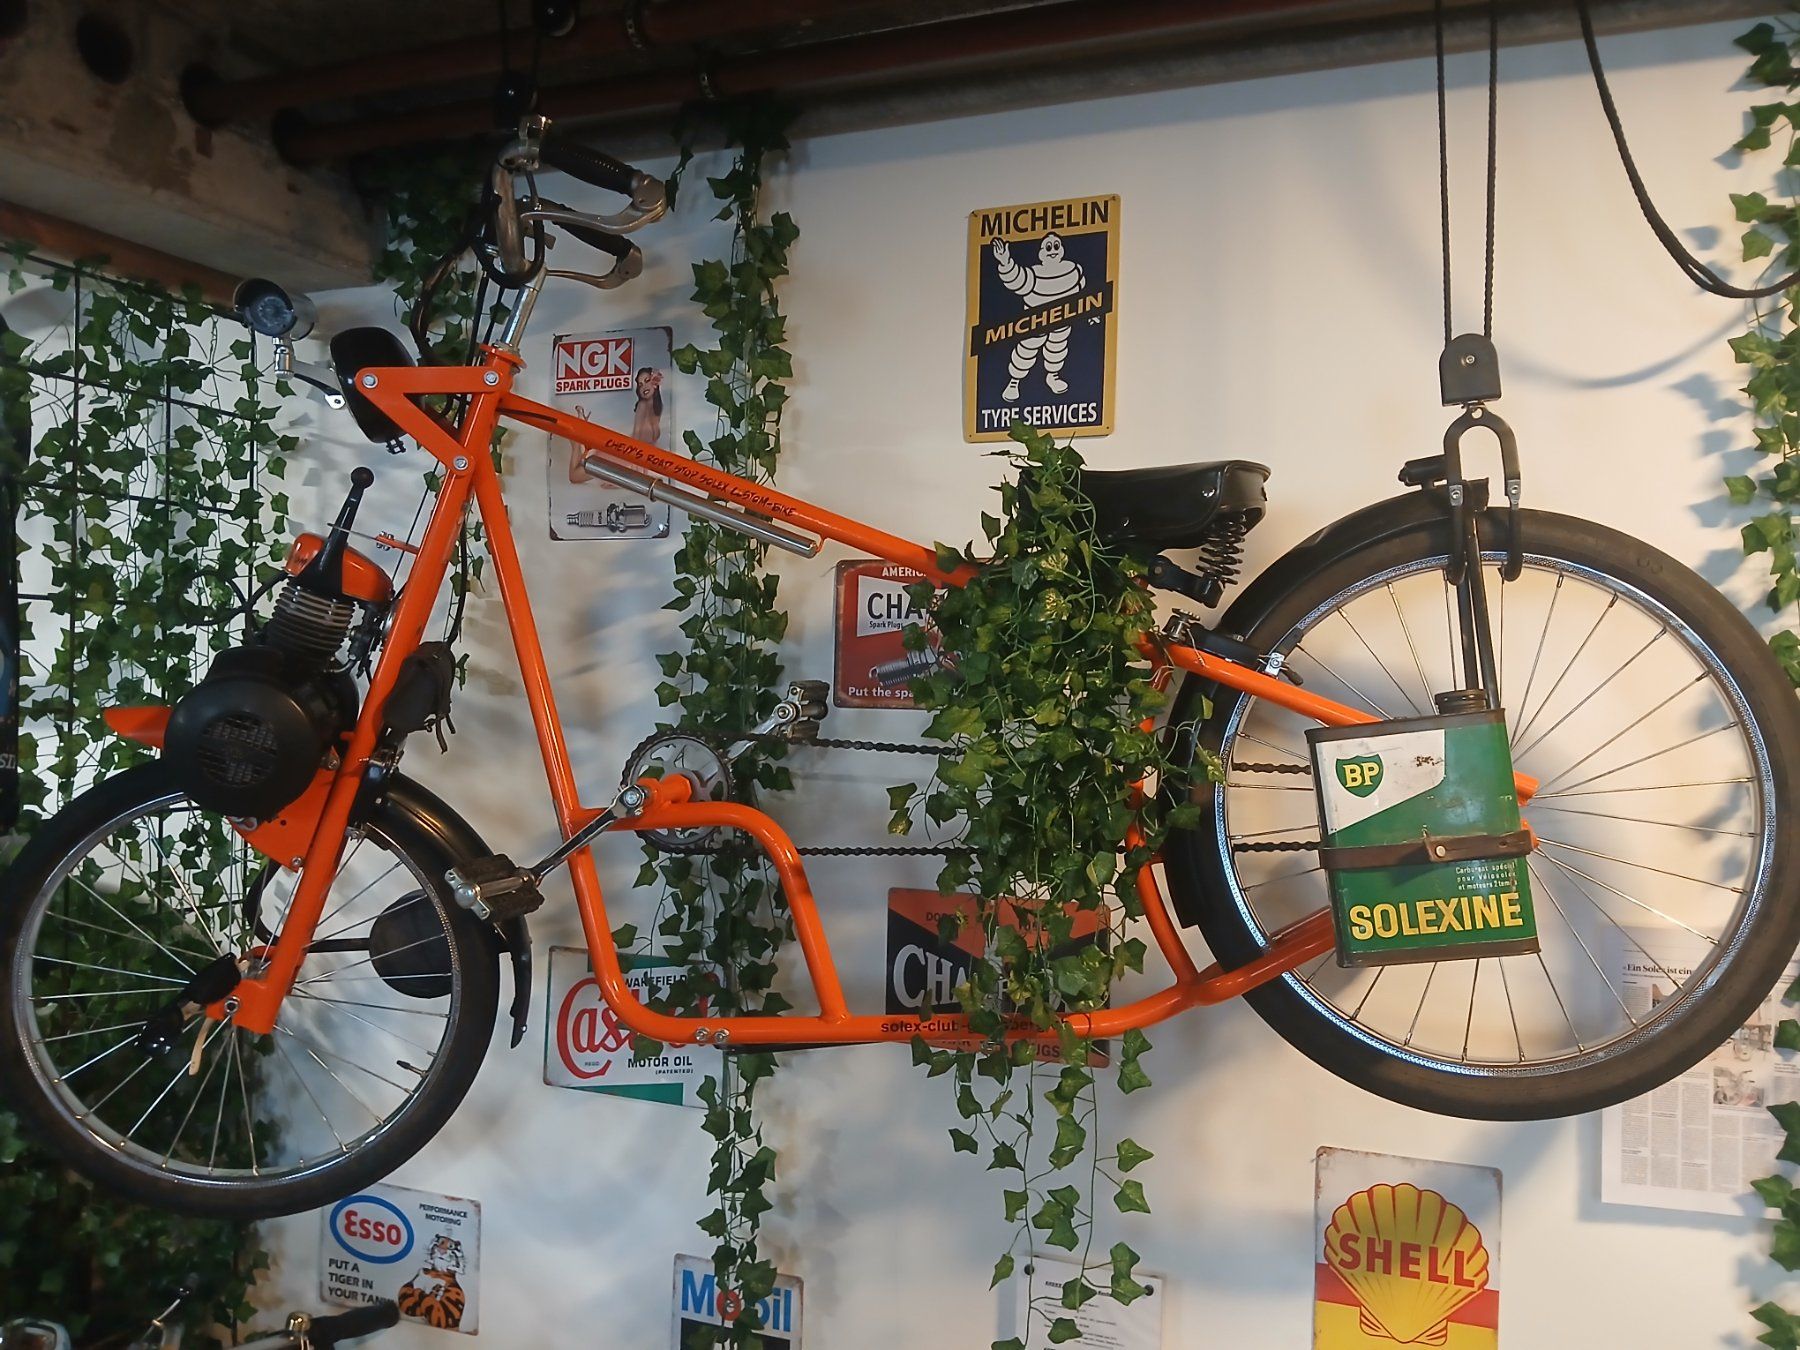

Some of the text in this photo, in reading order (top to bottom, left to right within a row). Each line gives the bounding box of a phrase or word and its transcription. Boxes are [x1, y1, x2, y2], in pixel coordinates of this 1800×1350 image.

[980, 200, 1109, 238] MICHELIN
[984, 291, 1103, 345] MICHELIN
[557, 338, 631, 379] NGK
[556, 377, 630, 393] SPARK PLUGS
[1023, 402, 1098, 426] SERVICES
[647, 453, 672, 471] ROAD
[673, 464, 699, 479] STOP
[699, 473, 728, 493] SOLEX
[869, 620, 887, 630] Spark
[848, 686, 869, 697] Put
[872, 686, 893, 698] the
[1343, 761, 1381, 789] BP
[1498, 879, 1518, 887] tems
[1349, 891, 1524, 941] SOLEXINE
[1642, 964, 1666, 974] Sole
[1667, 965, 1678, 974] ist
[627, 1055, 693, 1068] MOTOR OIL
[418, 1203, 468, 1219] PERFORMANCE
[425, 1213, 462, 1226] MOTORING
[328, 1258, 360, 1273] PUT A
[1338, 1232, 1475, 1288] SHELL
[328, 1272, 374, 1290] TIGER IN
[328, 1286, 359, 1301] YOUR
